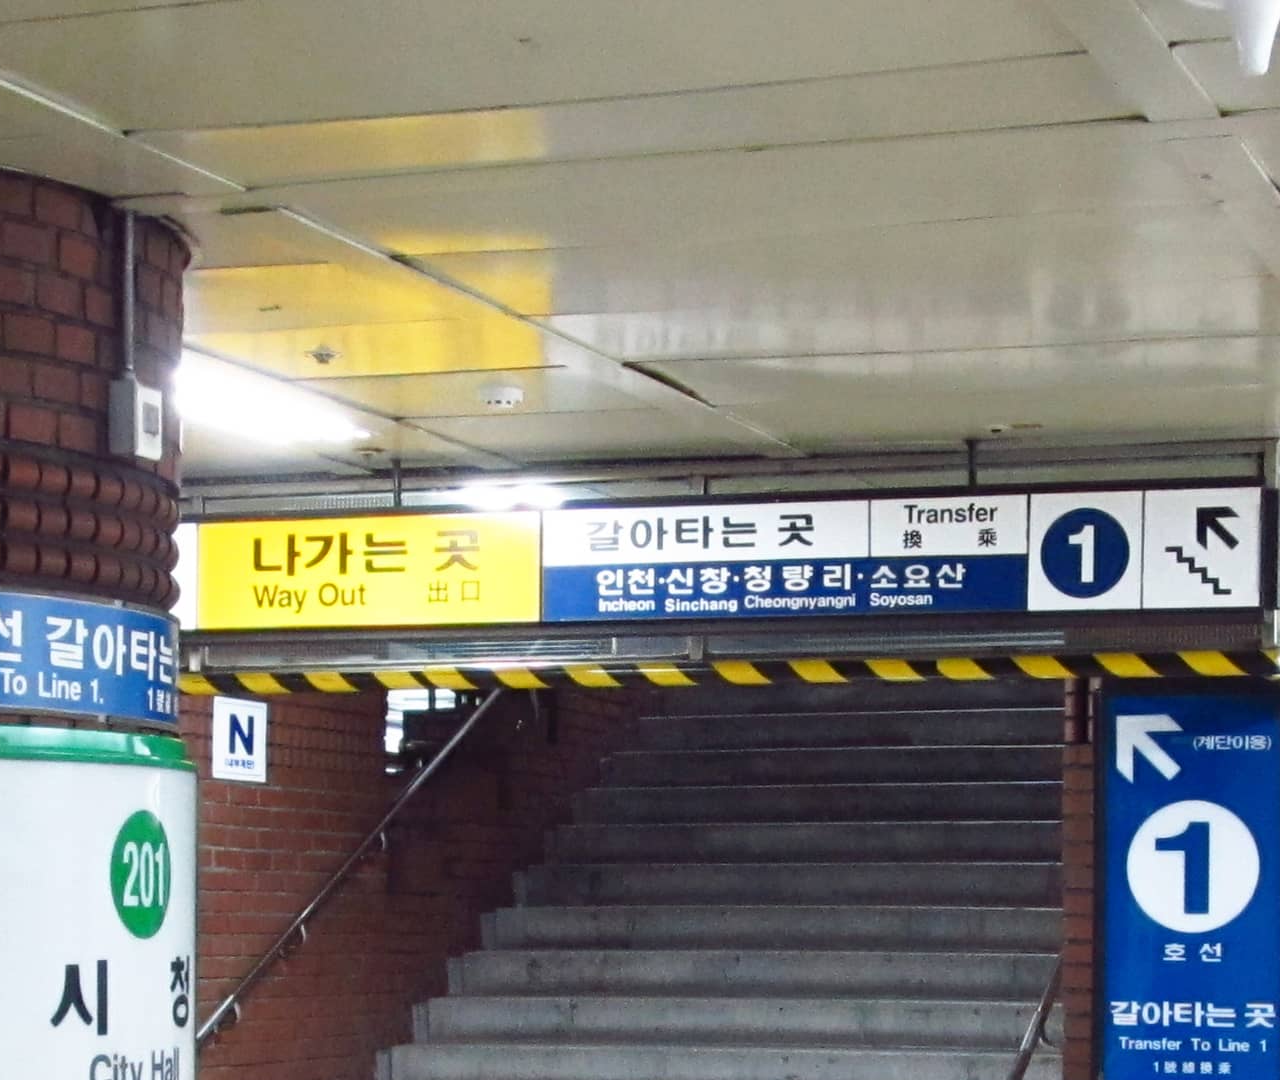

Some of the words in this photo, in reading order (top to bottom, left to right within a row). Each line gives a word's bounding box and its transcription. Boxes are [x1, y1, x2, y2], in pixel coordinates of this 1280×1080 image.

[586, 515, 757, 552] 갈아타는
[777, 513, 814, 547] 곳
[903, 504, 998, 525] Transfer
[254, 531, 407, 577] 나가는
[435, 529, 480, 571] 곳
[1068, 525, 1096, 583] 1
[254, 584, 305, 614] Way
[318, 582, 367, 607] Out
[427, 580, 481, 604] 出口
[597, 597, 655, 612] Incheon
[664, 598, 738, 613] Sinchang
[744, 594, 856, 611] Cheongnyangni
[869, 592, 933, 608] Soyosan
[46, 615, 174, 685] 갈아타는
[0, 667, 28, 697] To
[37, 671, 81, 702] Line
[229, 713, 255, 756] N
[122, 840, 167, 907] 201
[1155, 820, 1210, 914] 1
[1110, 1001, 1237, 1027] 갈아타는
[1244, 1003, 1276, 1028] 곳
[1119, 1036, 1183, 1050] Transfer
[1190, 1037, 1212, 1051] To
[1219, 1037, 1250, 1052] Line
[1259, 1039, 1266, 1052] 1
